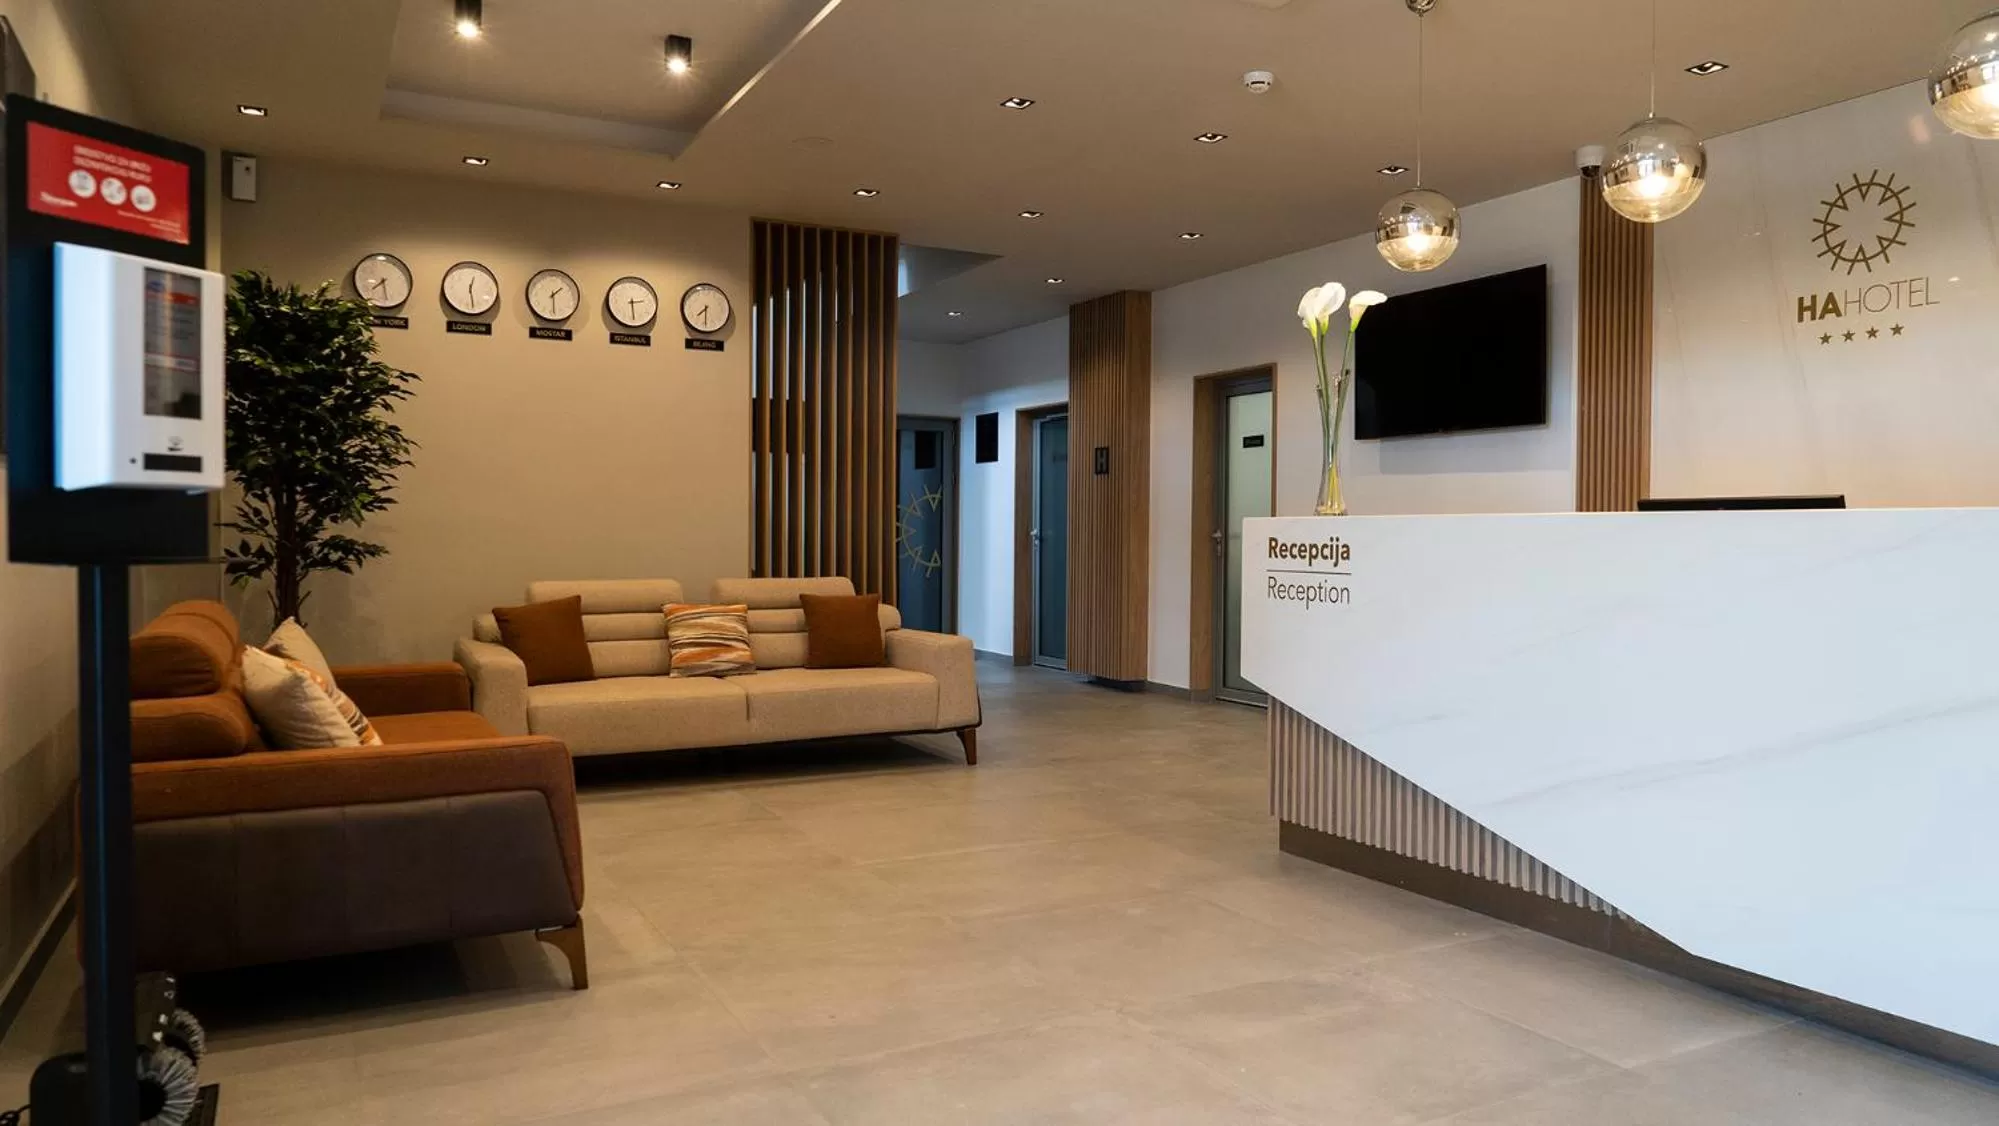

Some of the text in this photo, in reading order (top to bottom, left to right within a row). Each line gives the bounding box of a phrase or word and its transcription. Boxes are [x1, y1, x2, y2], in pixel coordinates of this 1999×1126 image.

[452, 322, 486, 332] LONDON
[536, 329, 566, 338] MOSTAR
[614, 335, 646, 344] ISTANBUL
[1268, 536, 1350, 567] Recepcija
[1267, 576, 1350, 611] Reception
